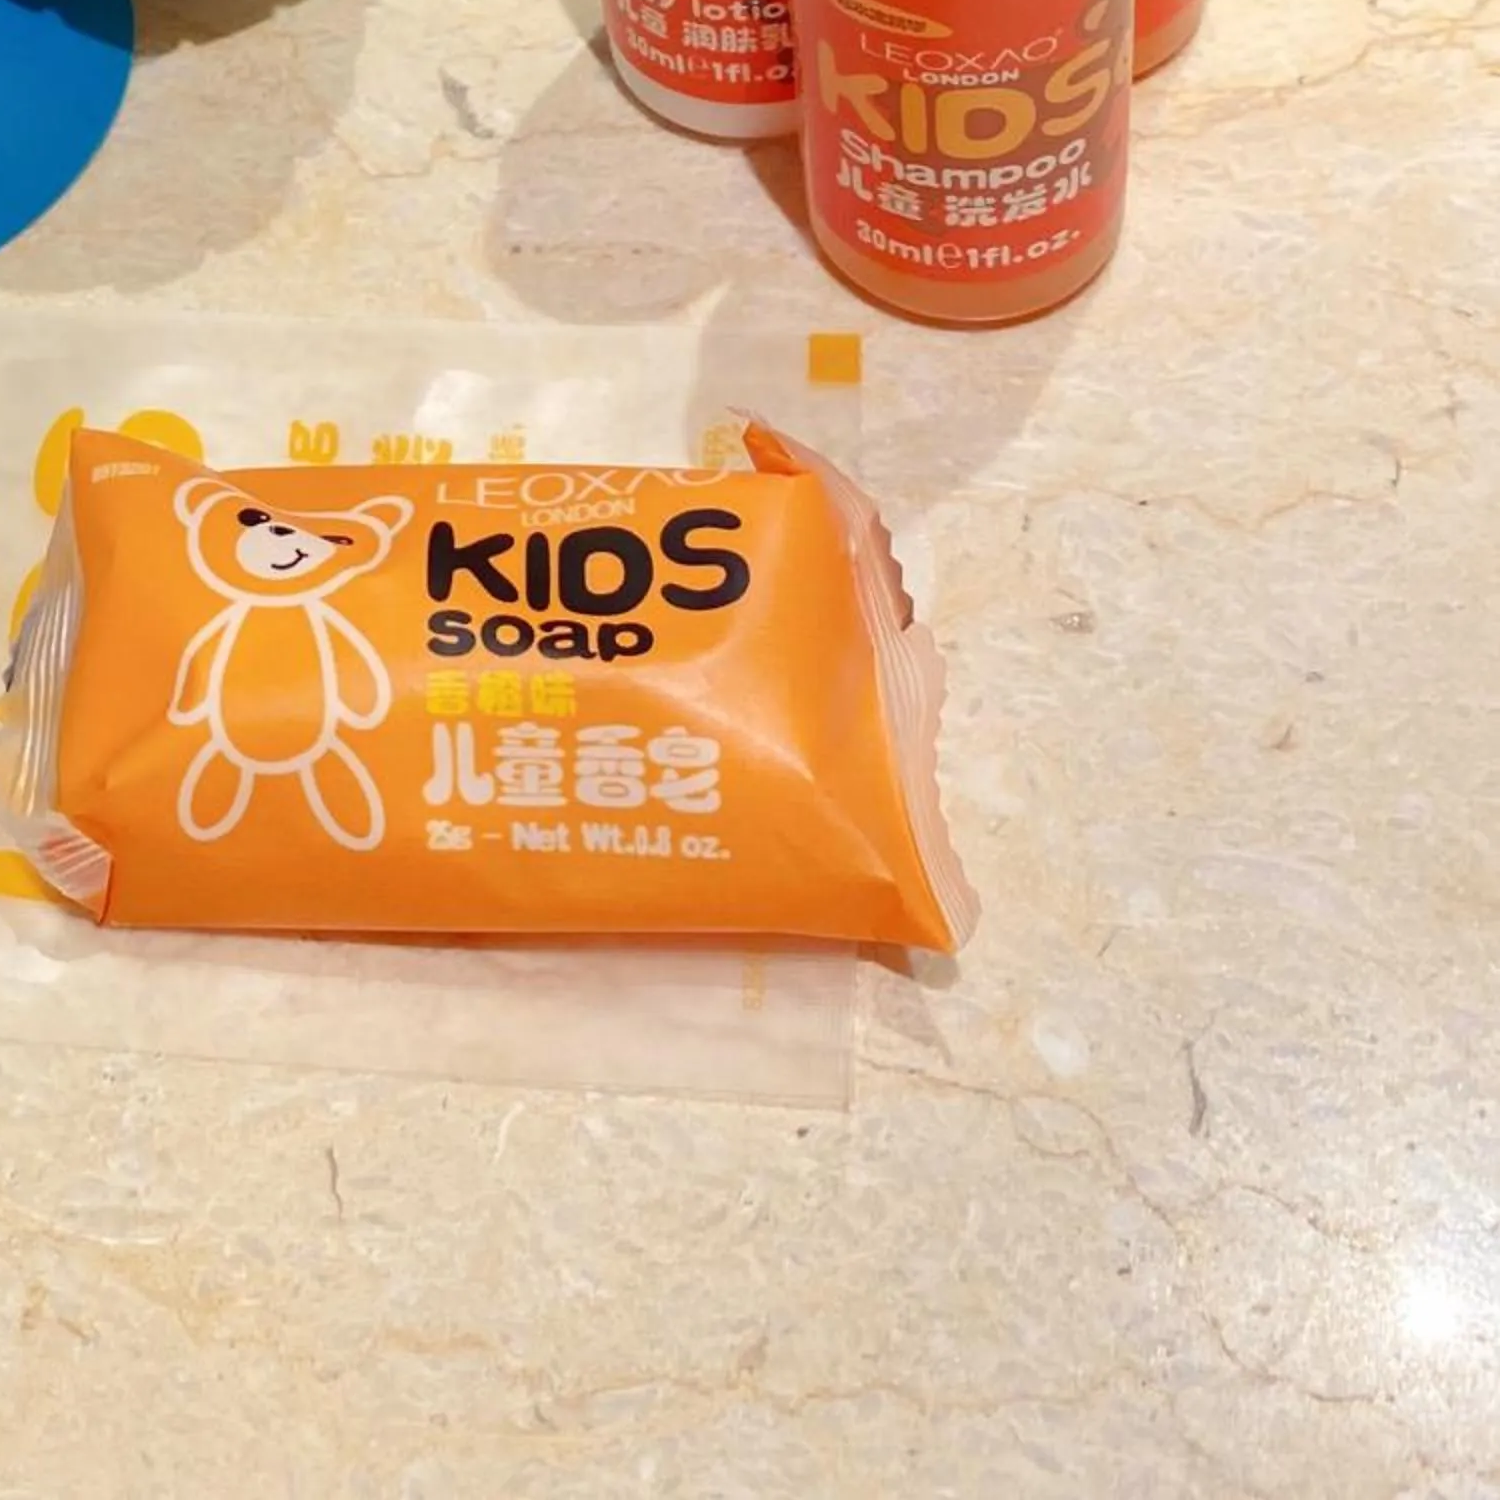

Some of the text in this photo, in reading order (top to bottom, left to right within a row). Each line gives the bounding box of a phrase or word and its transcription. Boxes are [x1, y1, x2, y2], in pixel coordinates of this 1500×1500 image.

[860, 32, 1058, 72] LEOXAO
[903, 67, 1019, 87] LONDON
[817, 38, 1112, 160] KIDS
[840, 128, 1087, 190] Shampoo
[836, 157, 924, 221] 儿童
[521, 496, 635, 528] LONDON
[428, 508, 750, 617] KIDS
[427, 610, 655, 663] soap
[421, 720, 722, 814] 儿童香皂
[511, 821, 571, 852] Net
[680, 835, 731, 860] oz.
